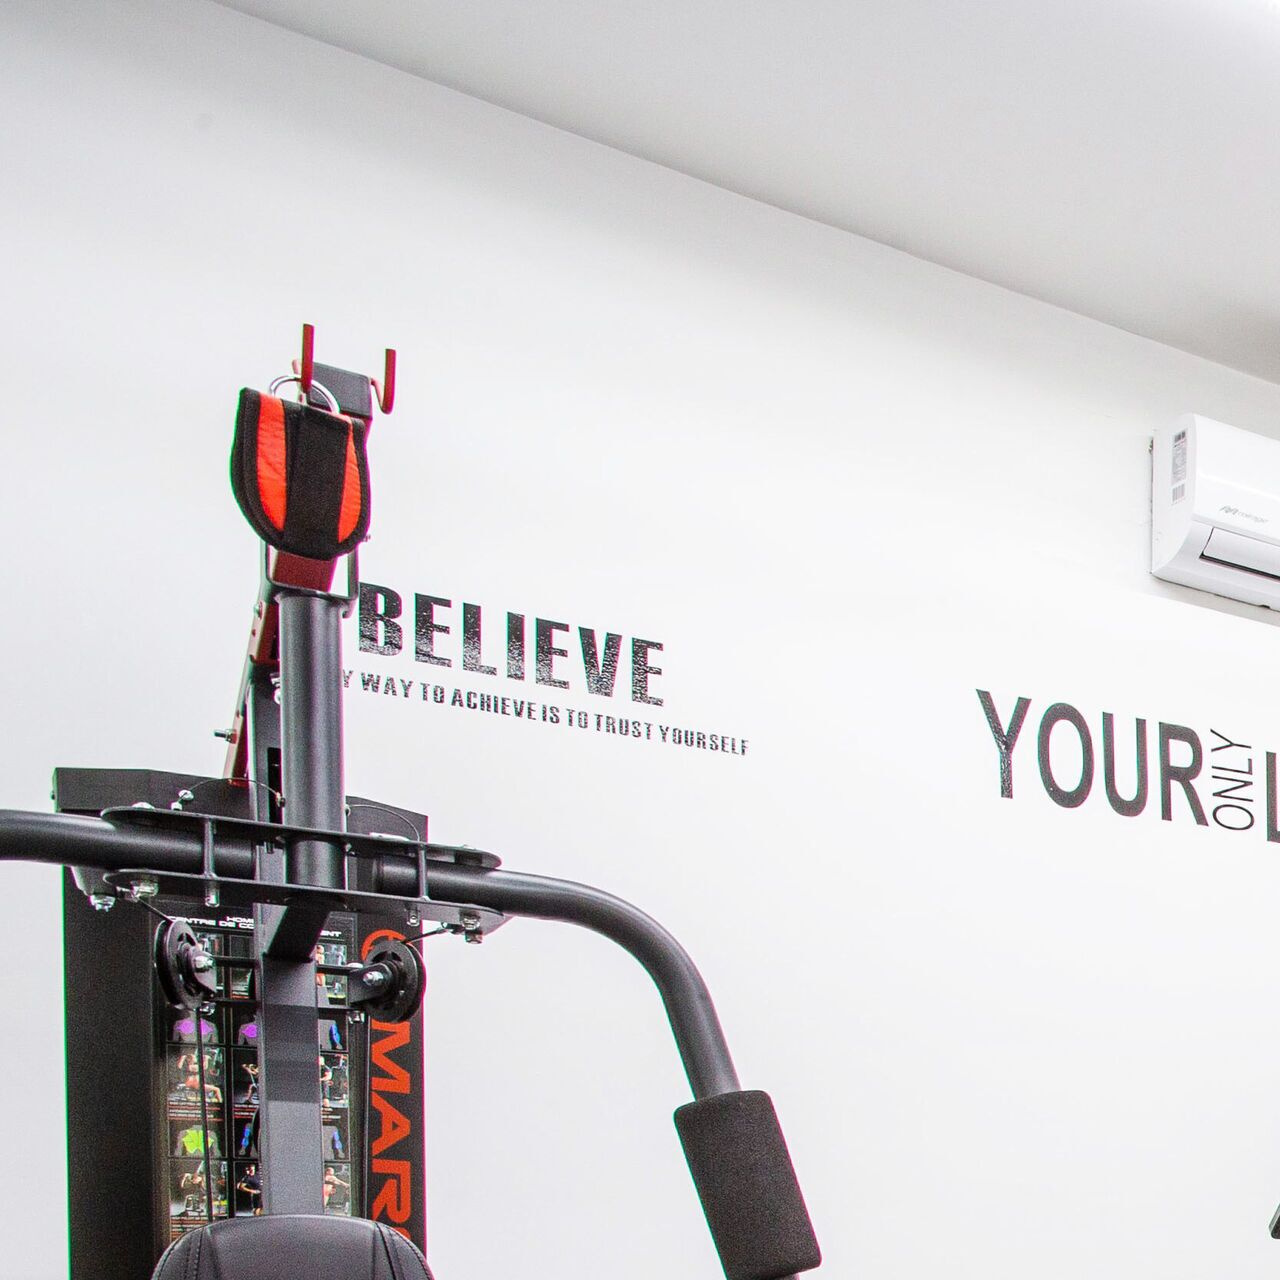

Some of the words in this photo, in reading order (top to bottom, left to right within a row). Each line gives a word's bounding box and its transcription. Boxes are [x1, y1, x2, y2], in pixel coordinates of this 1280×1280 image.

[357, 583, 663, 706] BELIEVE
[361, 673, 413, 698] WAY
[420, 683, 444, 703] TO
[451, 689, 536, 720] ACHIEVE
[542, 705, 559, 723] IS
[566, 709, 588, 728] TO
[594, 714, 651, 740] TRUST
[659, 725, 748, 755] YOURSELF
[976, 689, 1209, 826] YOUR
[1210, 729, 1254, 830] ONLY
[371, 1018, 411, 1241] MAR
